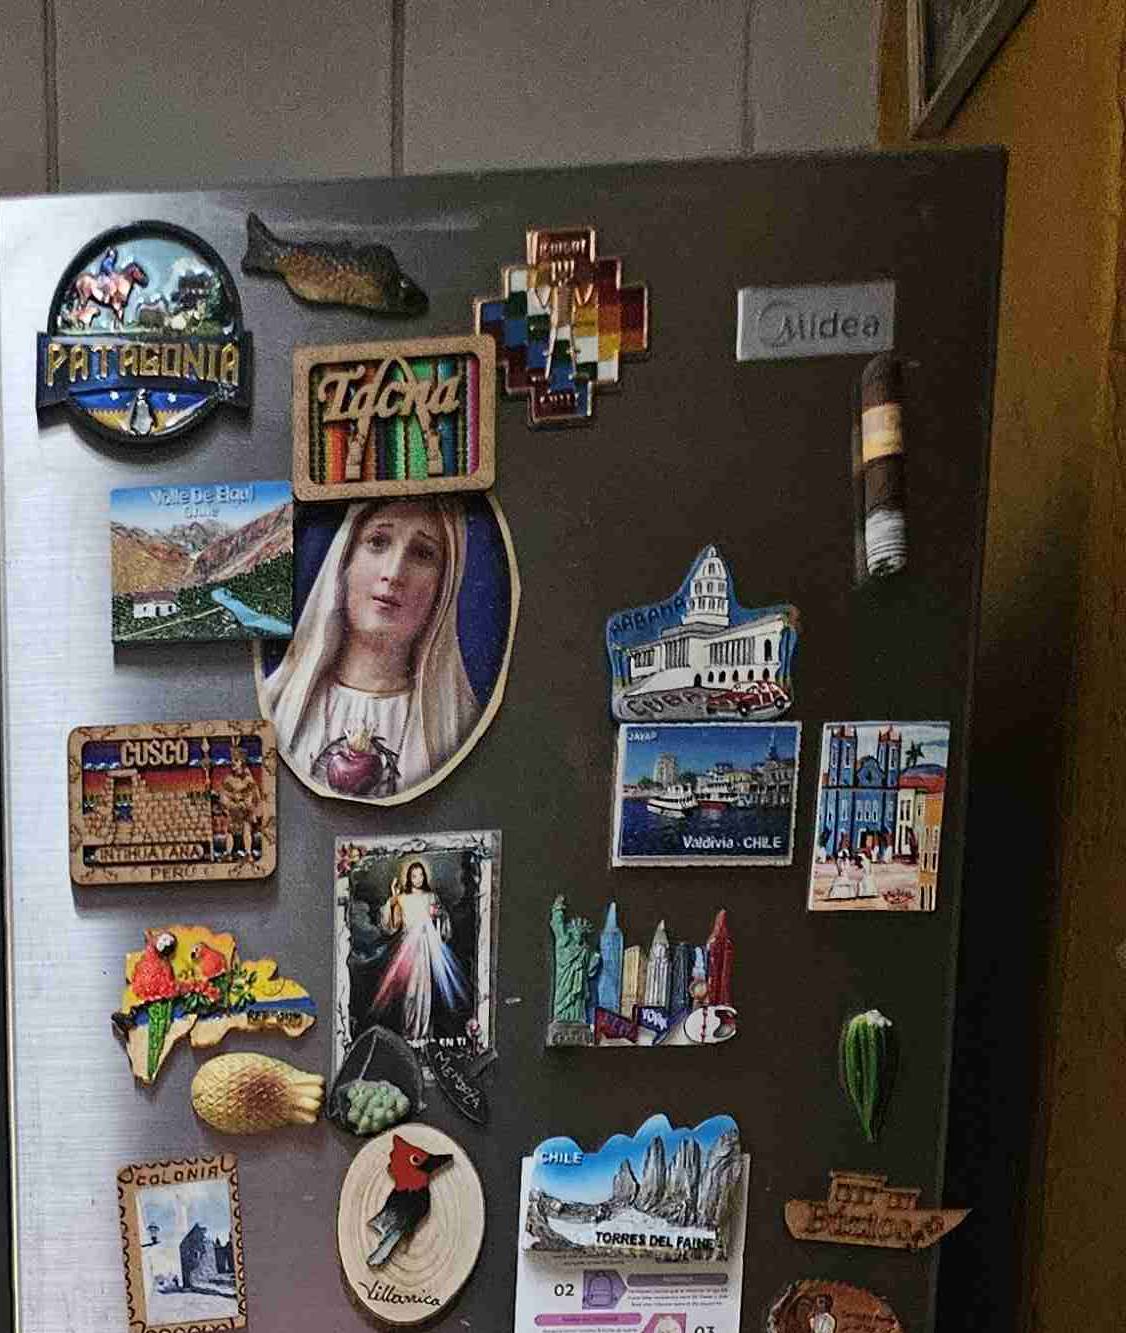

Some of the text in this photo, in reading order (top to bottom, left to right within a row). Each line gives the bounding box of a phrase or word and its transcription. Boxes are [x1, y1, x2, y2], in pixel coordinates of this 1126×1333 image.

[770, 307, 880, 342] Midea
[45, 343, 239, 386] PATAGONIA
[318, 364, 460, 422] Tacna
[121, 738, 189, 766] CUSCO
[682, 835, 782, 849] Valdivia CHILE
[541, 1152, 583, 1165] CHILE
[136, 1165, 218, 1186] COLONIA
[595, 1231, 646, 1247] TORRES
[649, 1234, 673, 1248] DEL
[554, 1284, 575, 1297] 02
